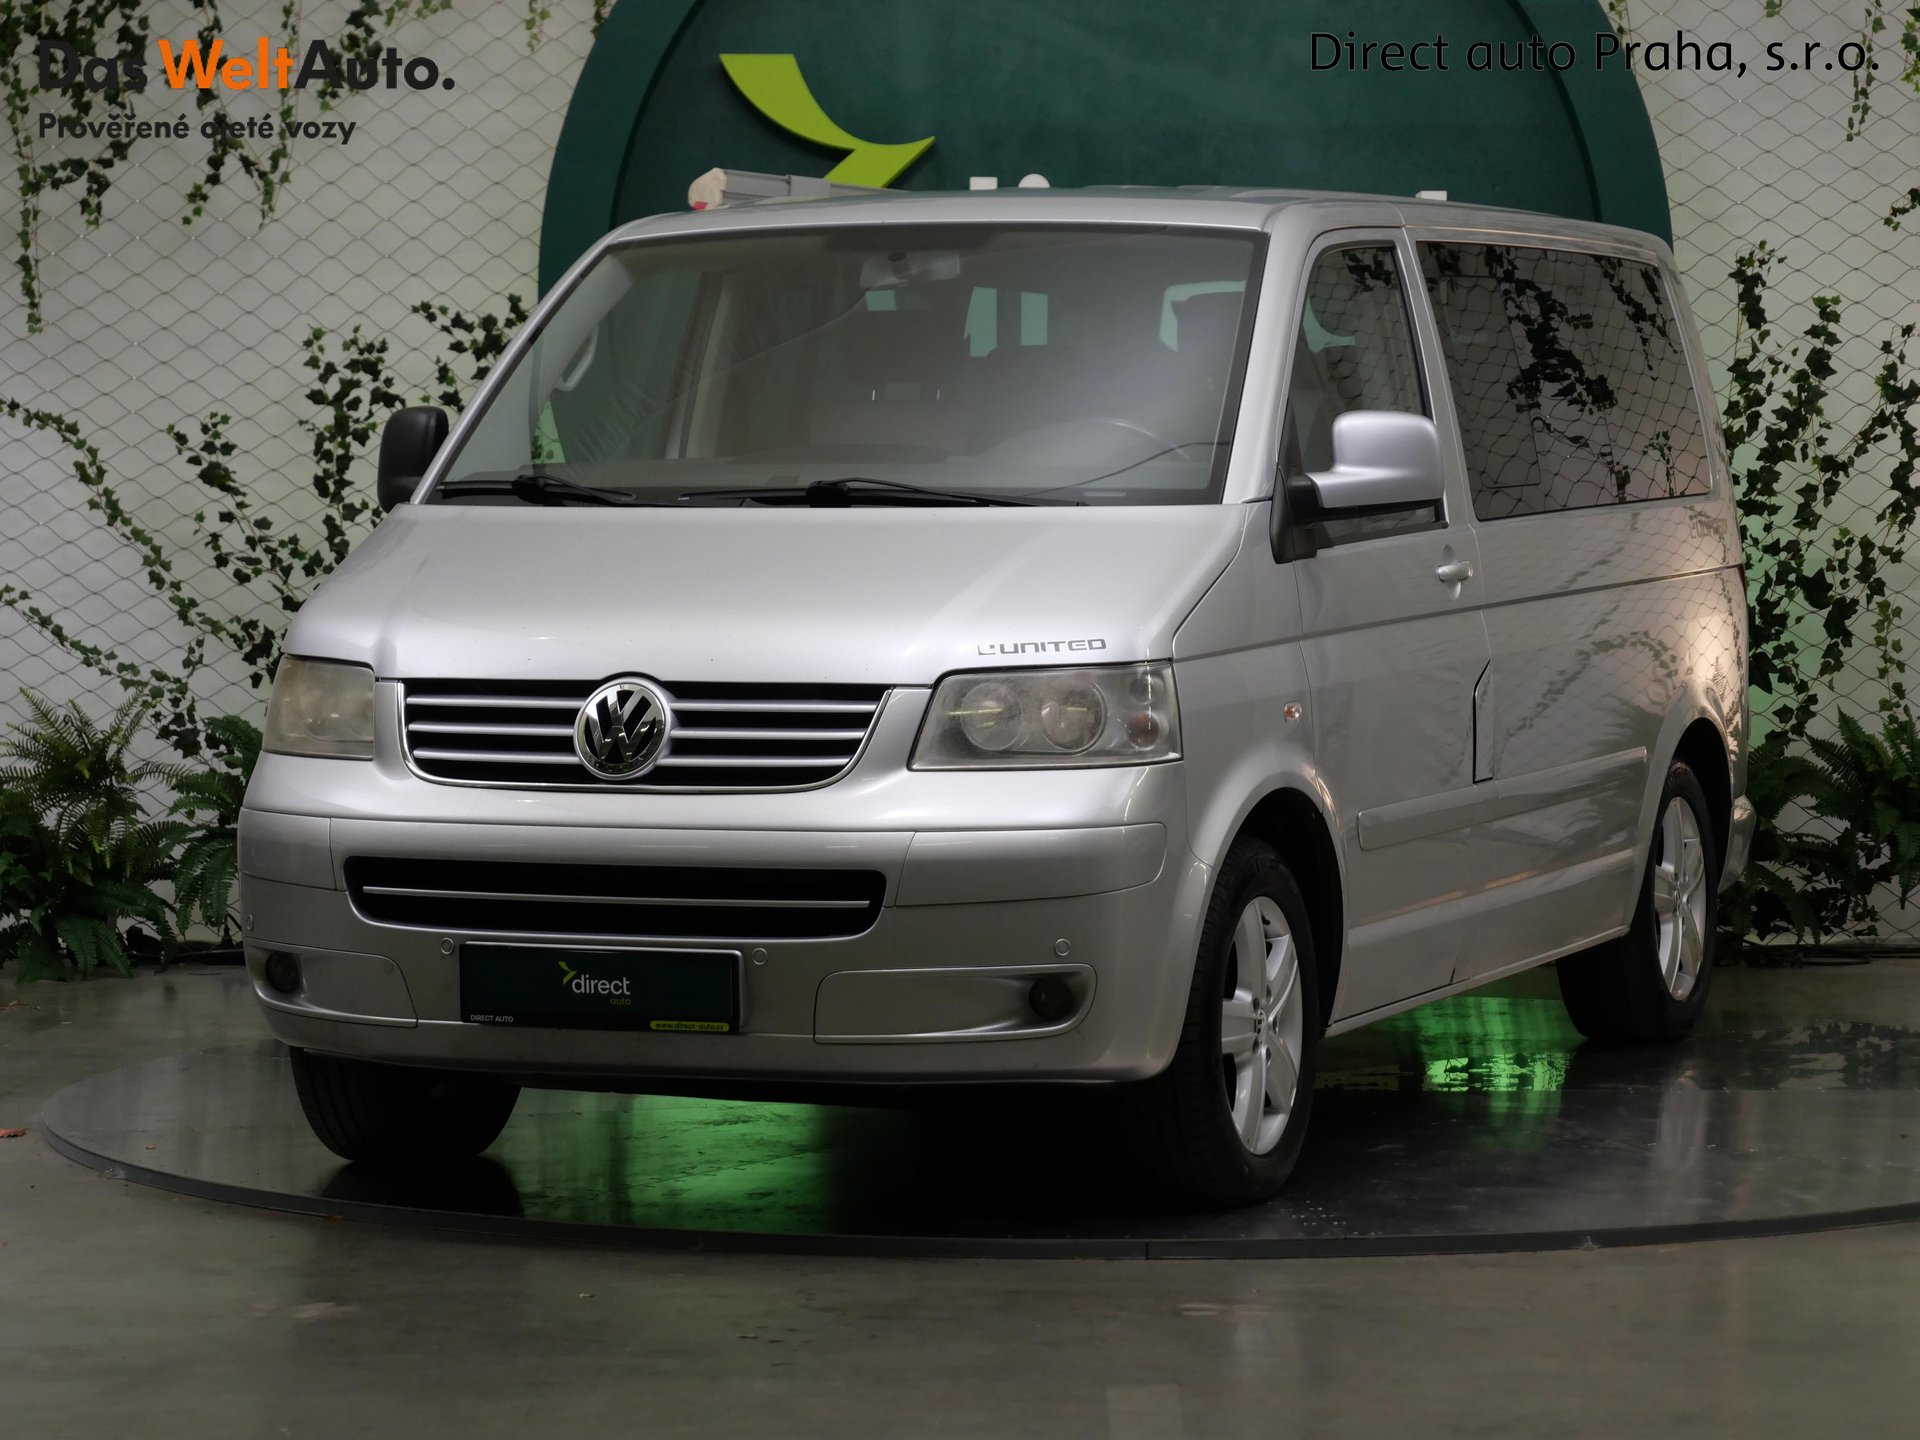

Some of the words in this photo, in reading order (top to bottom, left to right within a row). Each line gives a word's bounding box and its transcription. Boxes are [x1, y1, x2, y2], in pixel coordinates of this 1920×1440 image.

[1000, 638, 1107, 654] UNITED
[571, 974, 631, 995] direct
[610, 997, 632, 1006] auto
[470, 1014, 494, 1022] DIRECT
[495, 1015, 514, 1023] AUTO
[655, 1022, 724, 1031] www.direct-auto.cz
